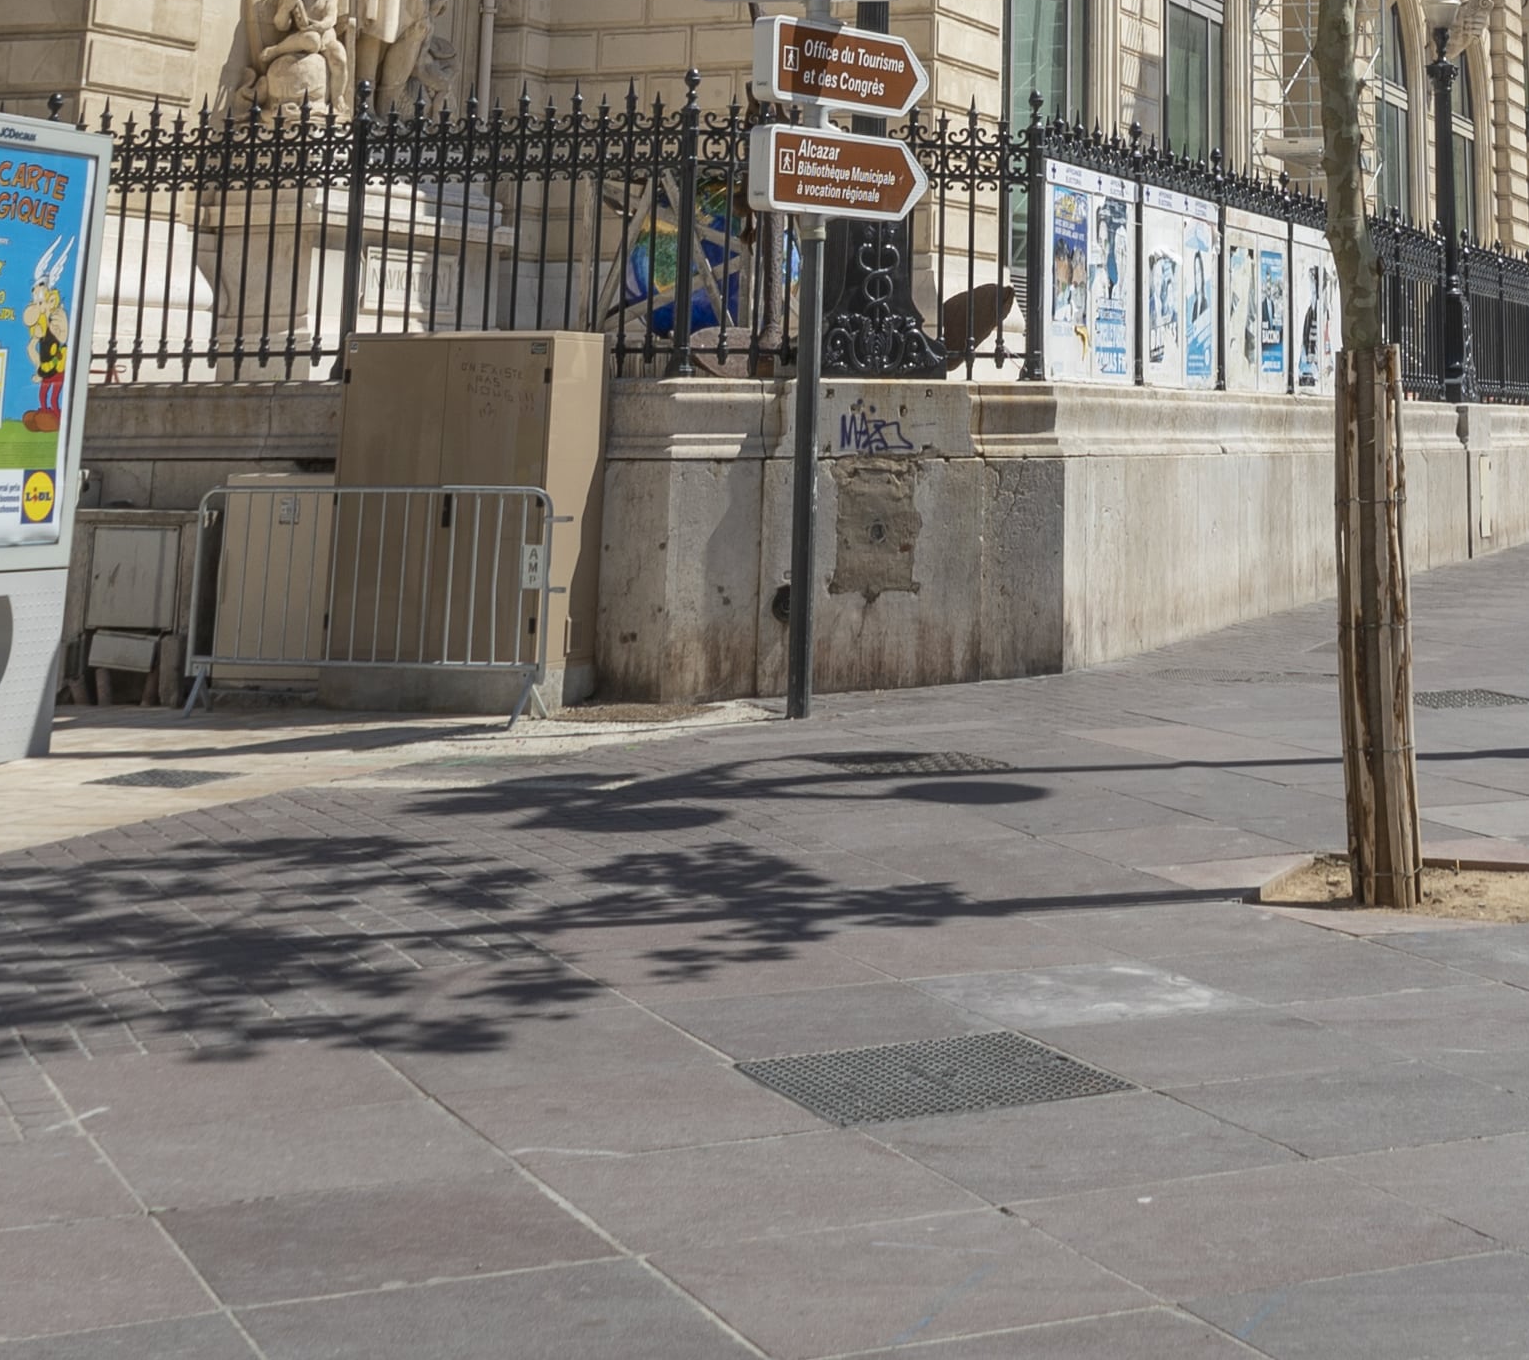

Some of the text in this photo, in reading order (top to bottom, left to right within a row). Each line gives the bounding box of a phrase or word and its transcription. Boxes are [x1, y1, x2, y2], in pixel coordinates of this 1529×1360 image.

[804, 39, 905, 74] Office du Tourisme
[803, 69, 884, 97] et des Congrès
[0, 127, 37, 142] JCDecaux
[798, 138, 840, 161] Alcazar
[797, 160, 896, 186] Bibliothèque Municipale
[797, 180, 880, 204] à vocation régionale
